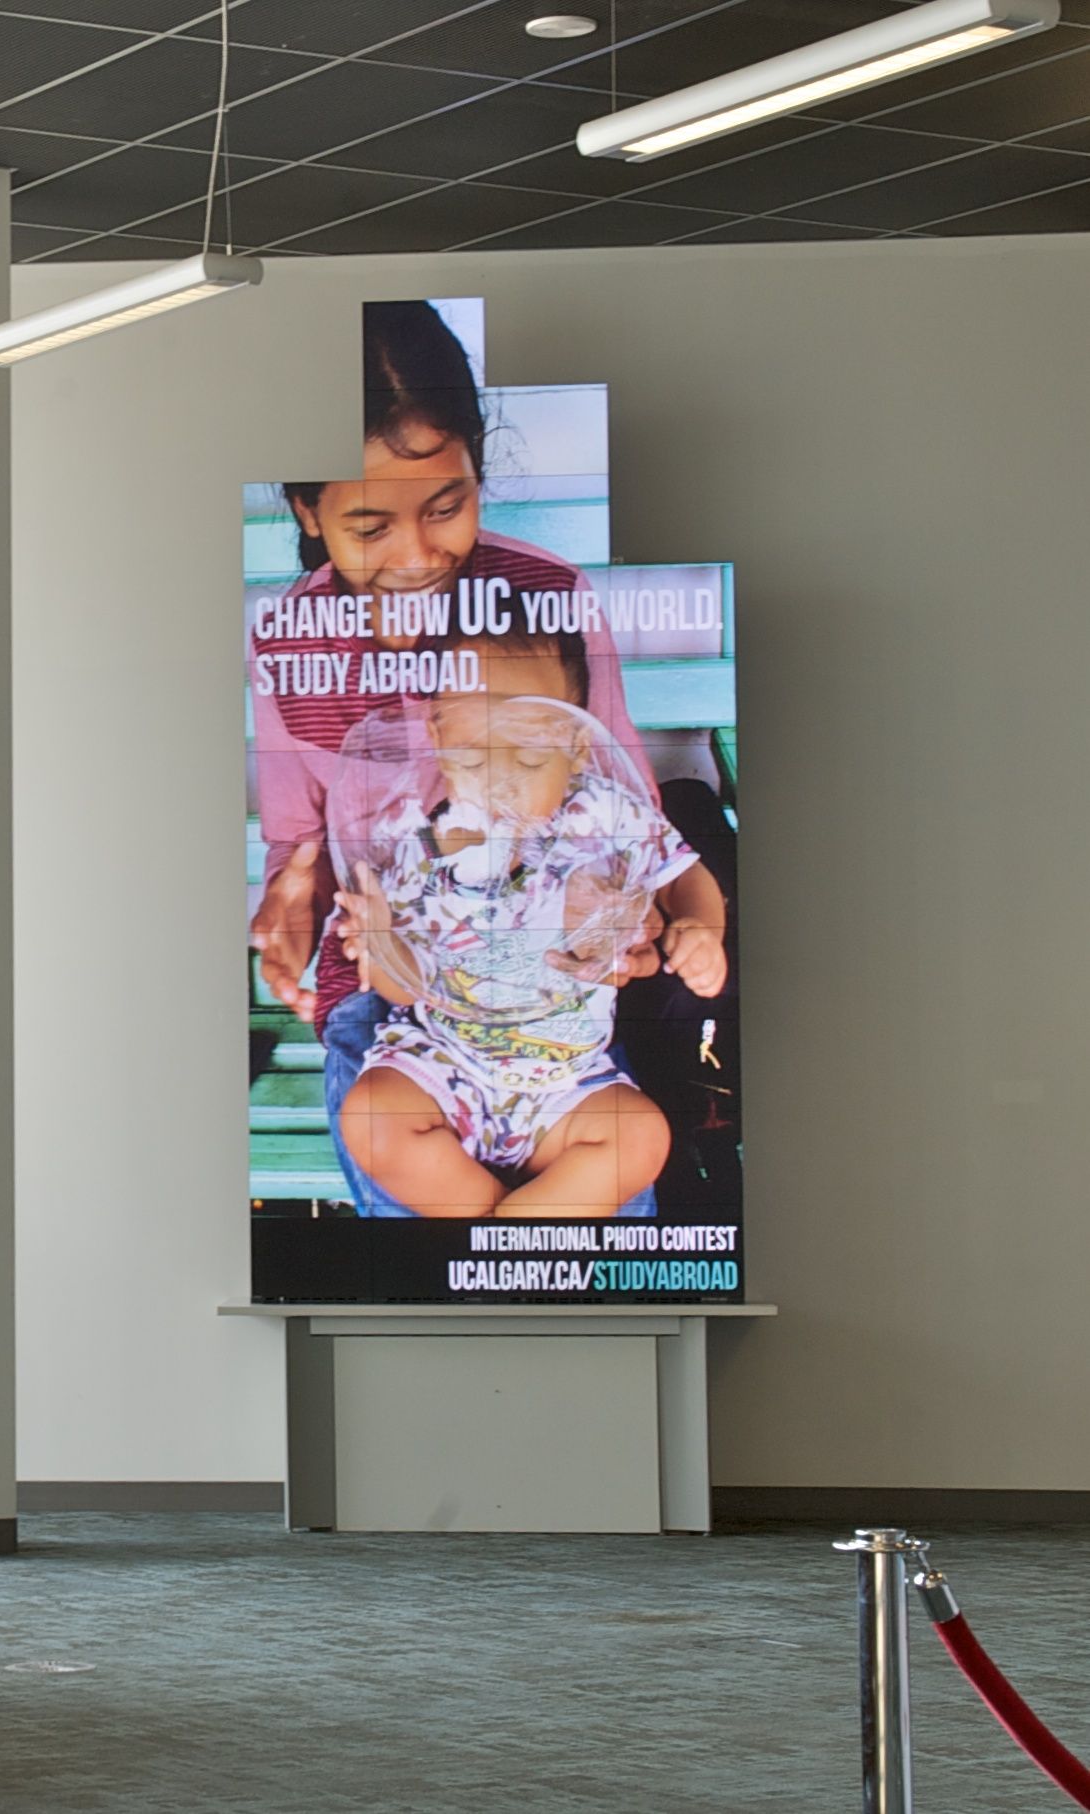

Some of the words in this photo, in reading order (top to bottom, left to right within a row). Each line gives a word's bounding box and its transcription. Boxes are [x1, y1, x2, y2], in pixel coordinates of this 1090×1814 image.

[255, 594, 373, 640] CHANGE
[381, 592, 451, 638] HOW
[458, 577, 512, 636] UC
[521, 590, 601, 634] YOUR
[609, 587, 724, 633] WORLD.
[255, 650, 350, 697] STUDY
[357, 649, 487, 695] ABROAD.
[470, 1226, 600, 1252] INTERNATIONAL
[602, 1226, 659, 1252] PHOTO
[661, 1226, 736, 1251] CONTEST
[448, 1261, 738, 1291] UCALGARY.CA/STUDYABROAD
